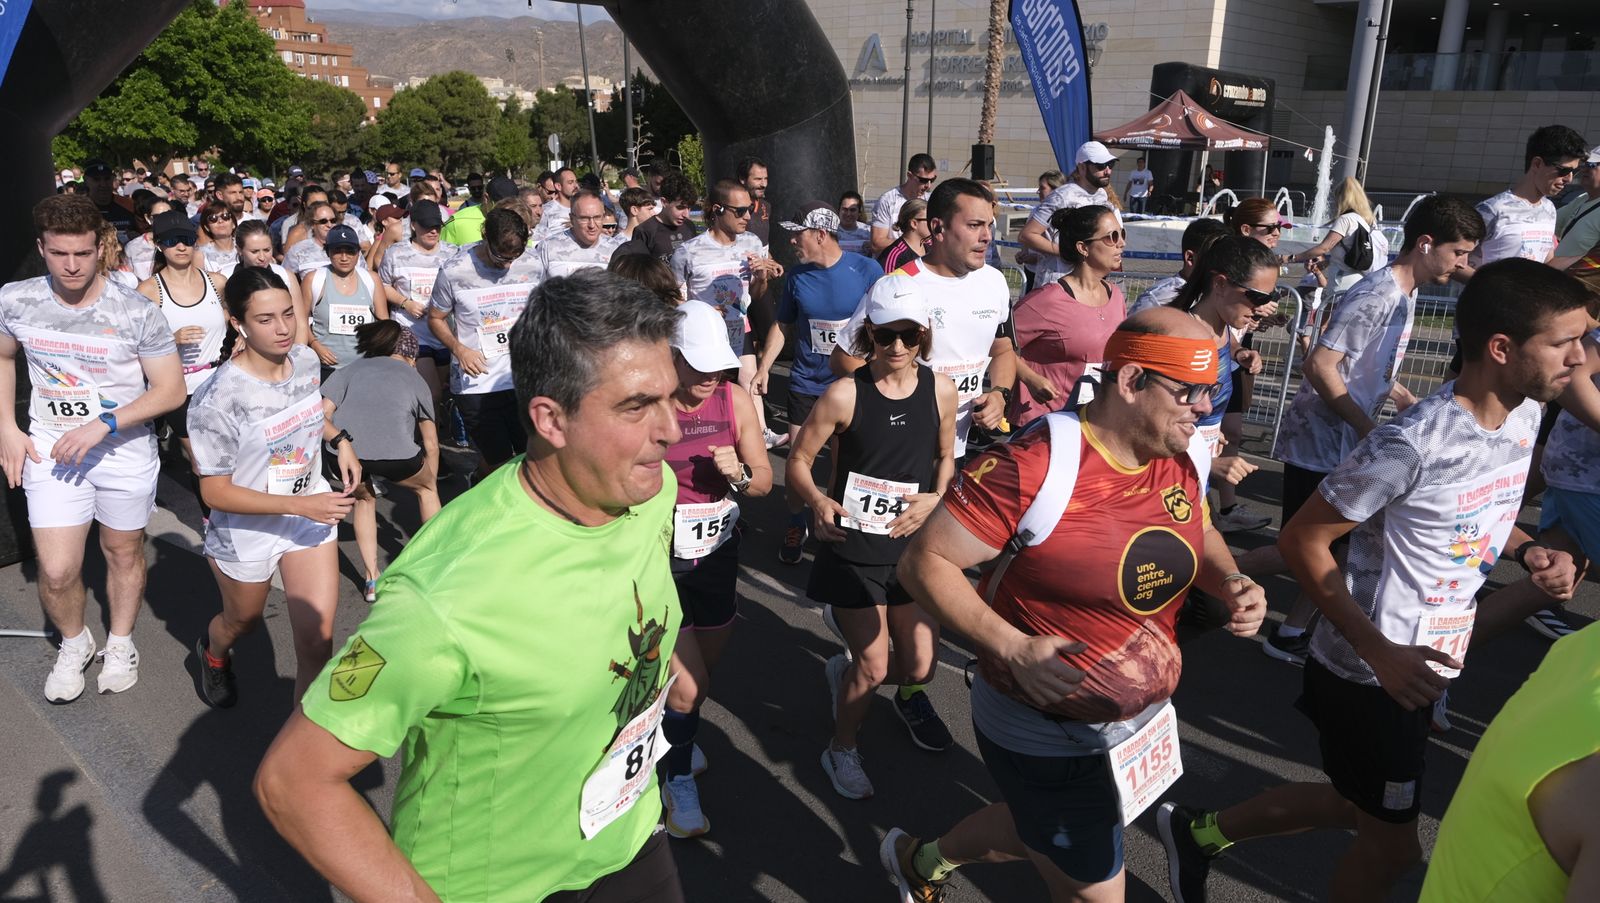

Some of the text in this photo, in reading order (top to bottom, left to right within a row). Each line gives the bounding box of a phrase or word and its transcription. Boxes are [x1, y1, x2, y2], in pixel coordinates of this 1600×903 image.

[340, 314, 365, 325] 189
[47, 401, 90, 417] 183
[685, 425, 718, 435] LURBEL
[860, 494, 902, 517] 154
[692, 514, 731, 540] 155
[1136, 562, 1156, 574] uno
[1137, 569, 1166, 583] entre
[1137, 575, 1173, 592] cienmil
[1134, 588, 1153, 602] .org
[625, 726, 657, 781] 87
[1126, 734, 1173, 791] 1155
